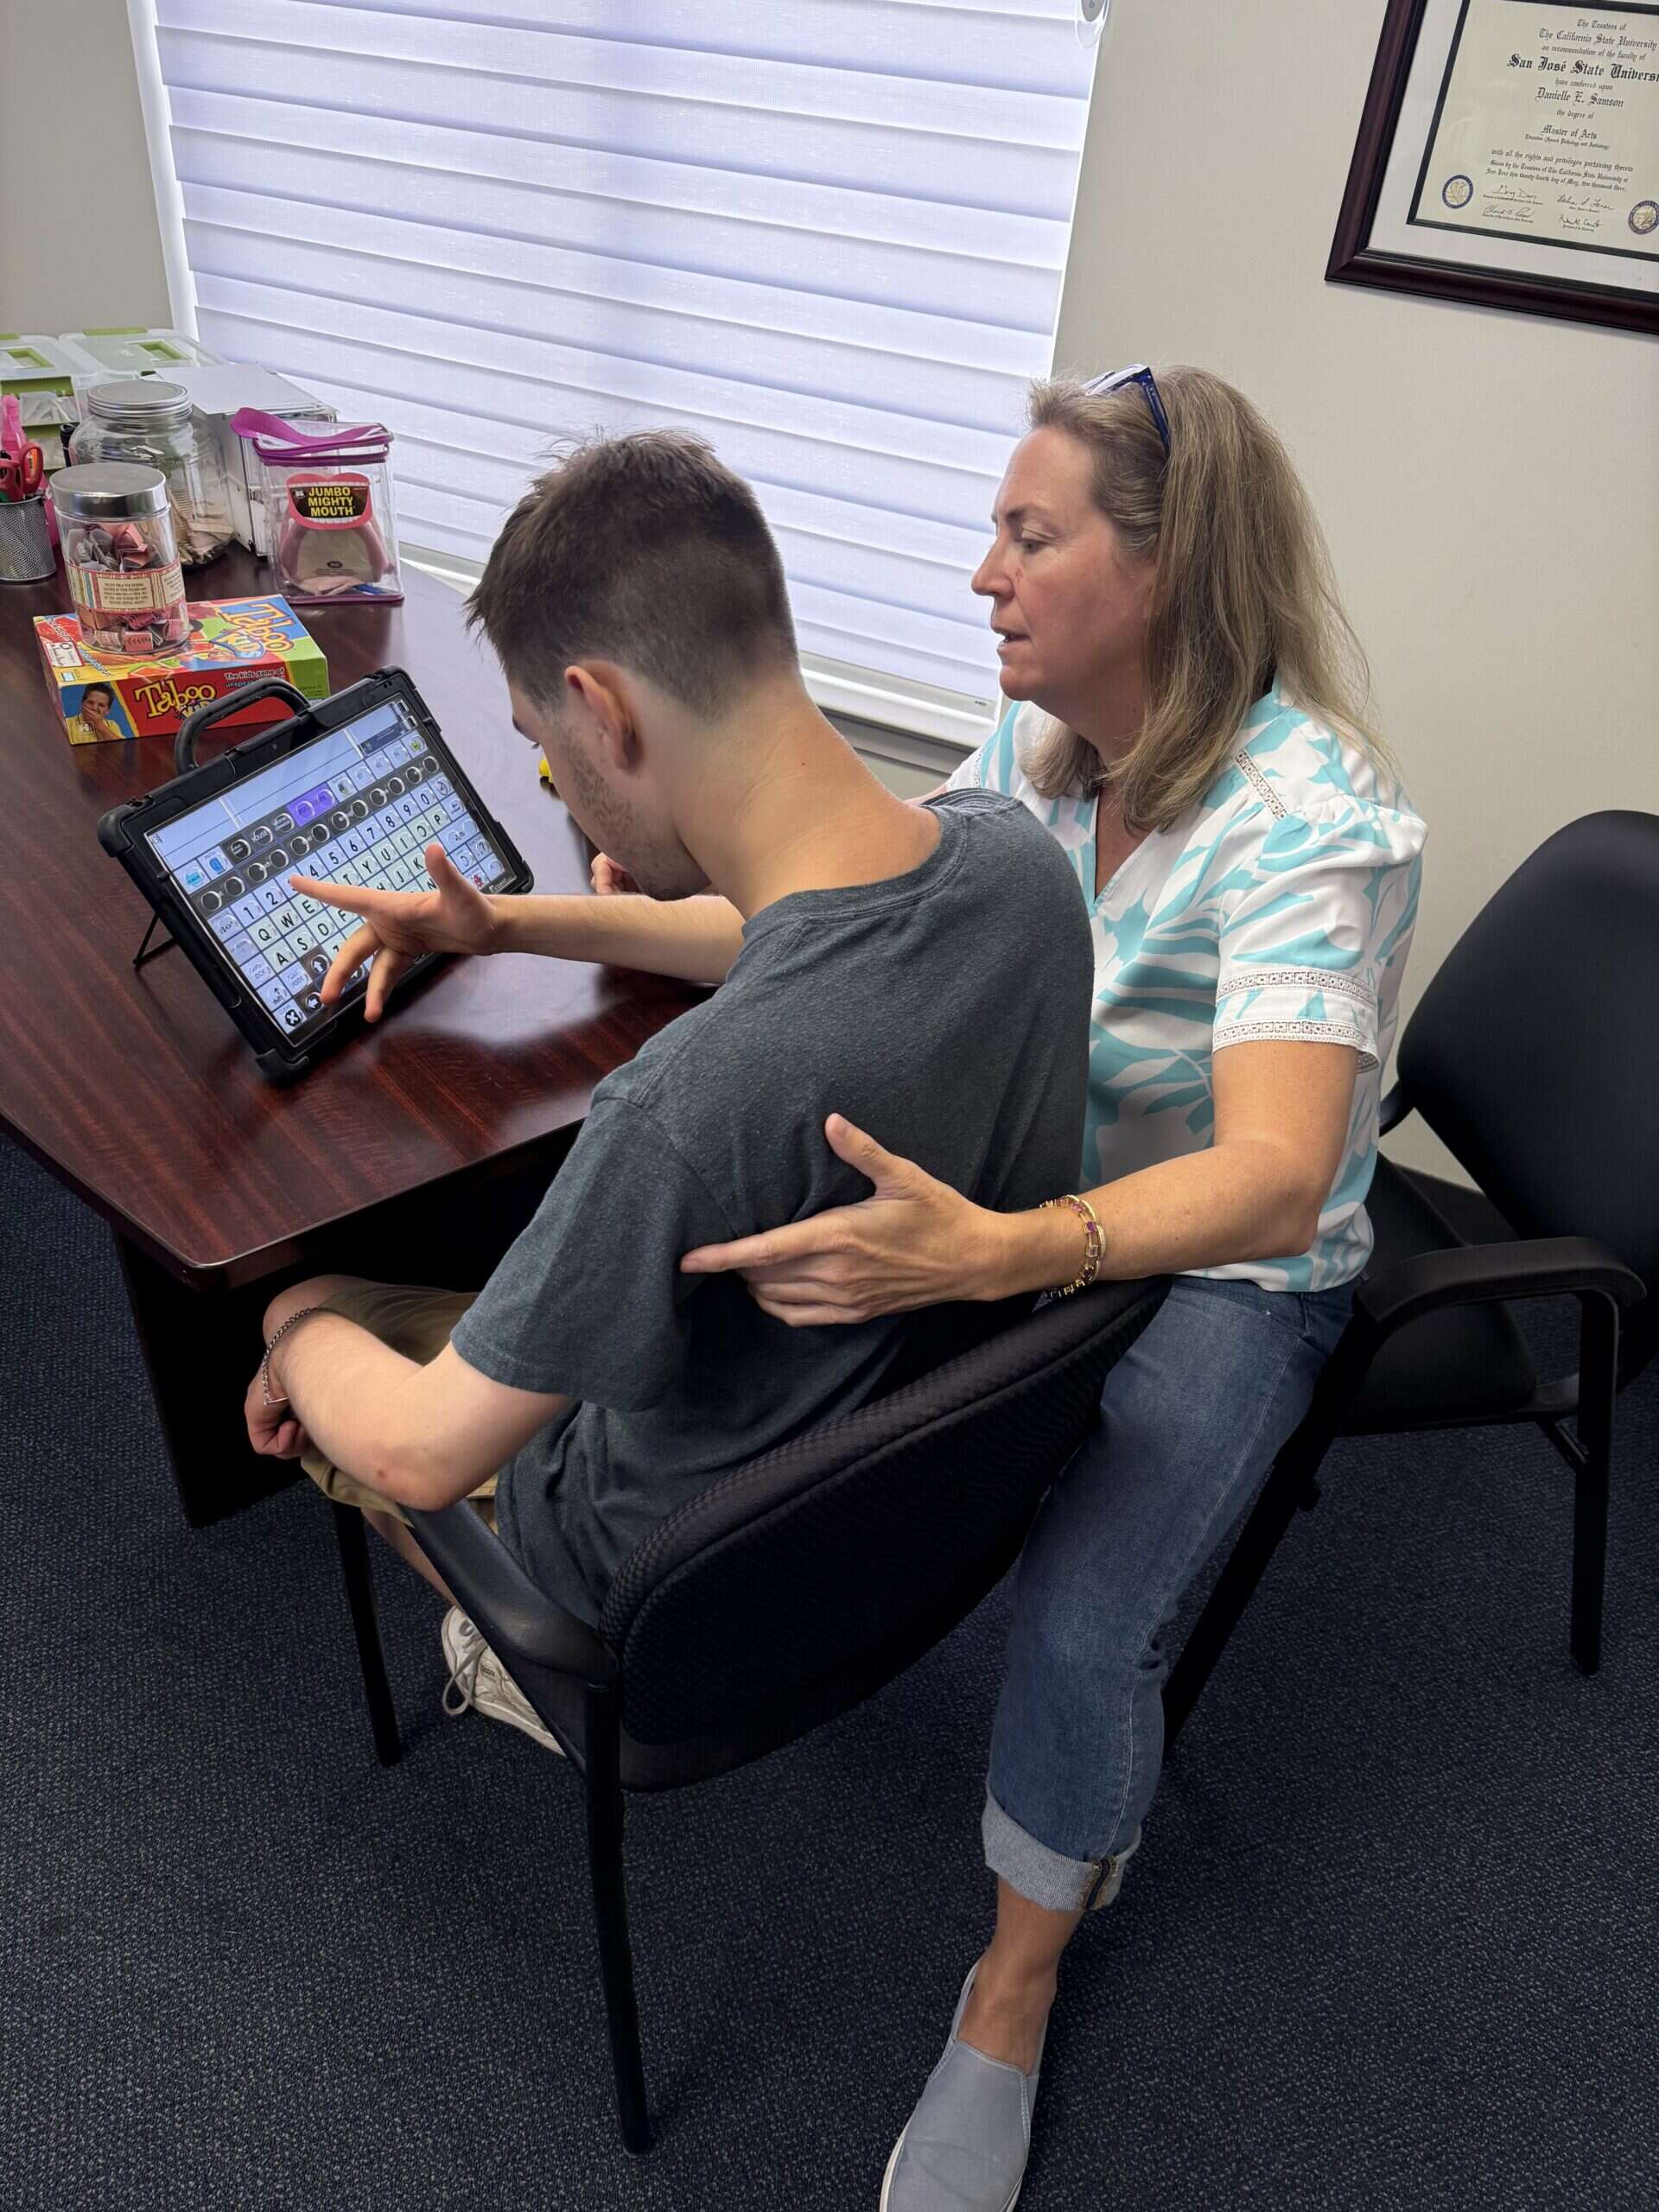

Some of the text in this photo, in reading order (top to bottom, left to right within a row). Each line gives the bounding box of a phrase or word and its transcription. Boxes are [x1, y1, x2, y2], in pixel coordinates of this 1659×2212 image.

[1577, 19, 1588, 28] The
[1592, 21, 1617, 30] Trustees
[1539, 28, 1657, 51] The California State University
[1606, 49, 1616, 58] the
[1507, 54, 1533, 69] San
[1538, 56, 1567, 72] José
[1570, 60, 1604, 76] State
[1535, 87, 1571, 102] Danielle
[1589, 93, 1624, 107] Samson
[1541, 124, 1598, 140] Master of Arts
[308, 486, 351, 497] JUMBO
[308, 496, 353, 507] MIGHTY
[311, 506, 353, 517] MOUTH
[219, 602, 295, 652] Taboo
[134, 679, 216, 719] Taboo
